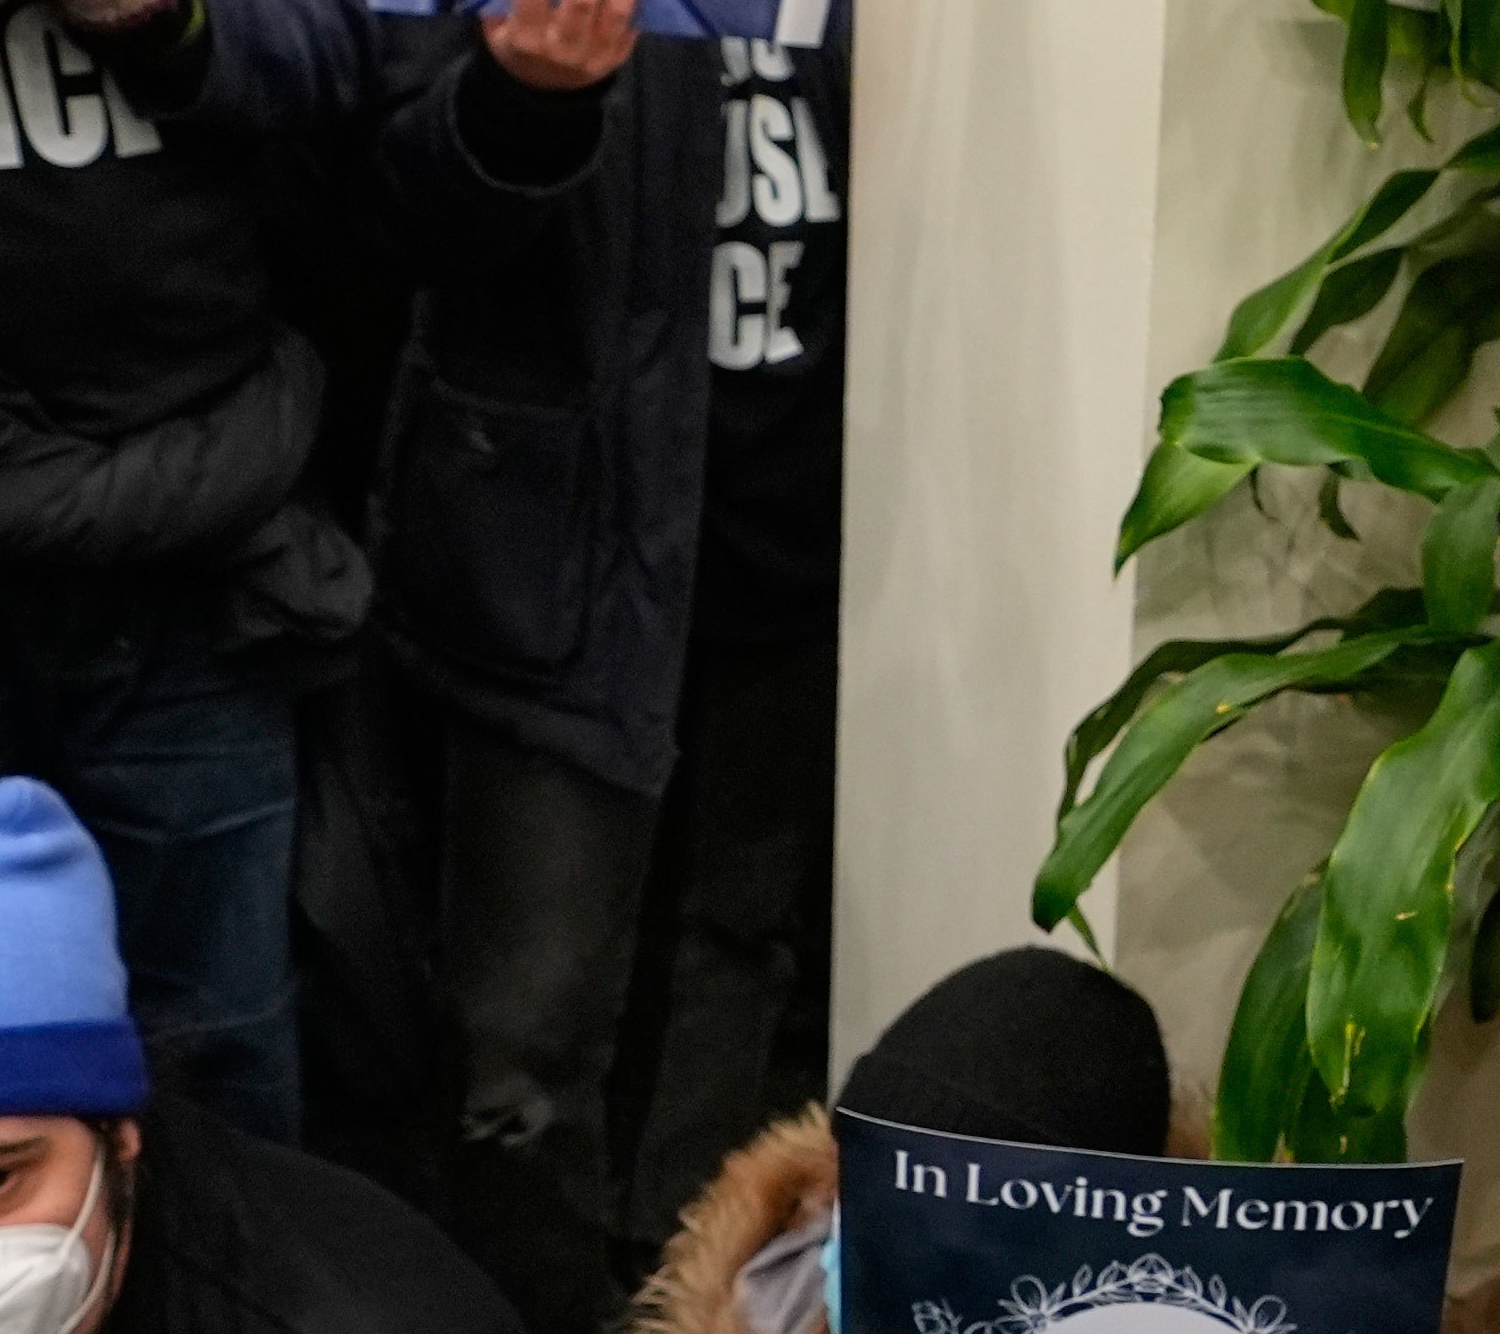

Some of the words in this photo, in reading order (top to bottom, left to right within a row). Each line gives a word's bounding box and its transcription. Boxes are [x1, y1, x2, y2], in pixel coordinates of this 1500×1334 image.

[709, 240, 804, 371] CE
[895, 1150, 947, 1198] In
[966, 1163, 1169, 1238] Loving
[1182, 1185, 1434, 1239] Memory
